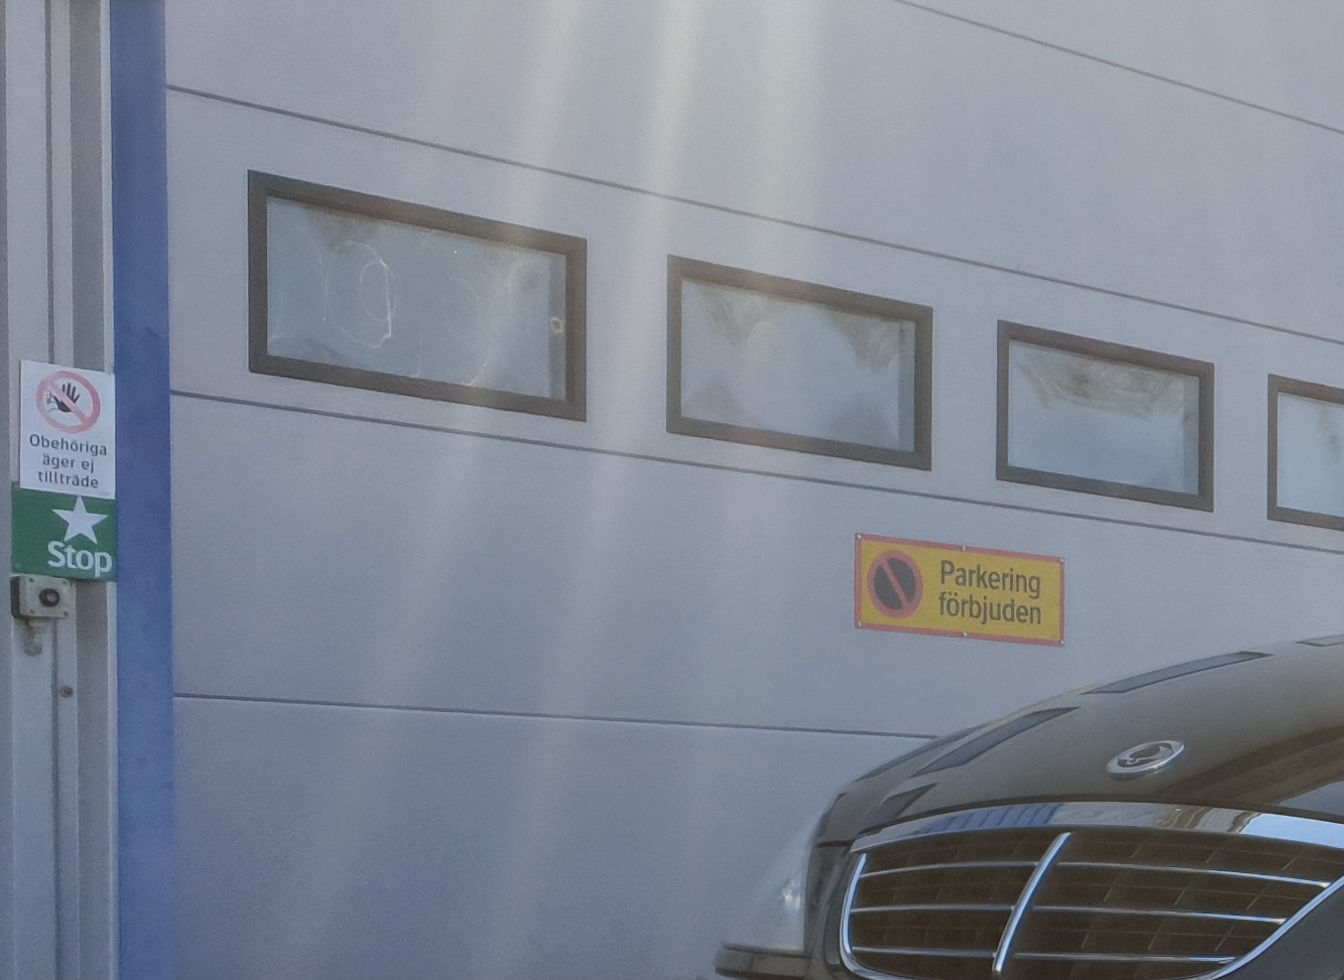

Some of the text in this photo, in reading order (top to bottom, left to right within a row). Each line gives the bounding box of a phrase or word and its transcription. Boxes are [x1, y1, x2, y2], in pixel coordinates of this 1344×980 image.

[29, 433, 108, 457] Obehöriga
[42, 455, 95, 474] äger ej
[38, 470, 99, 489] tillträde
[47, 541, 112, 578] Stop
[941, 559, 1041, 600] Parkering
[938, 591, 1042, 625] förbjuden
